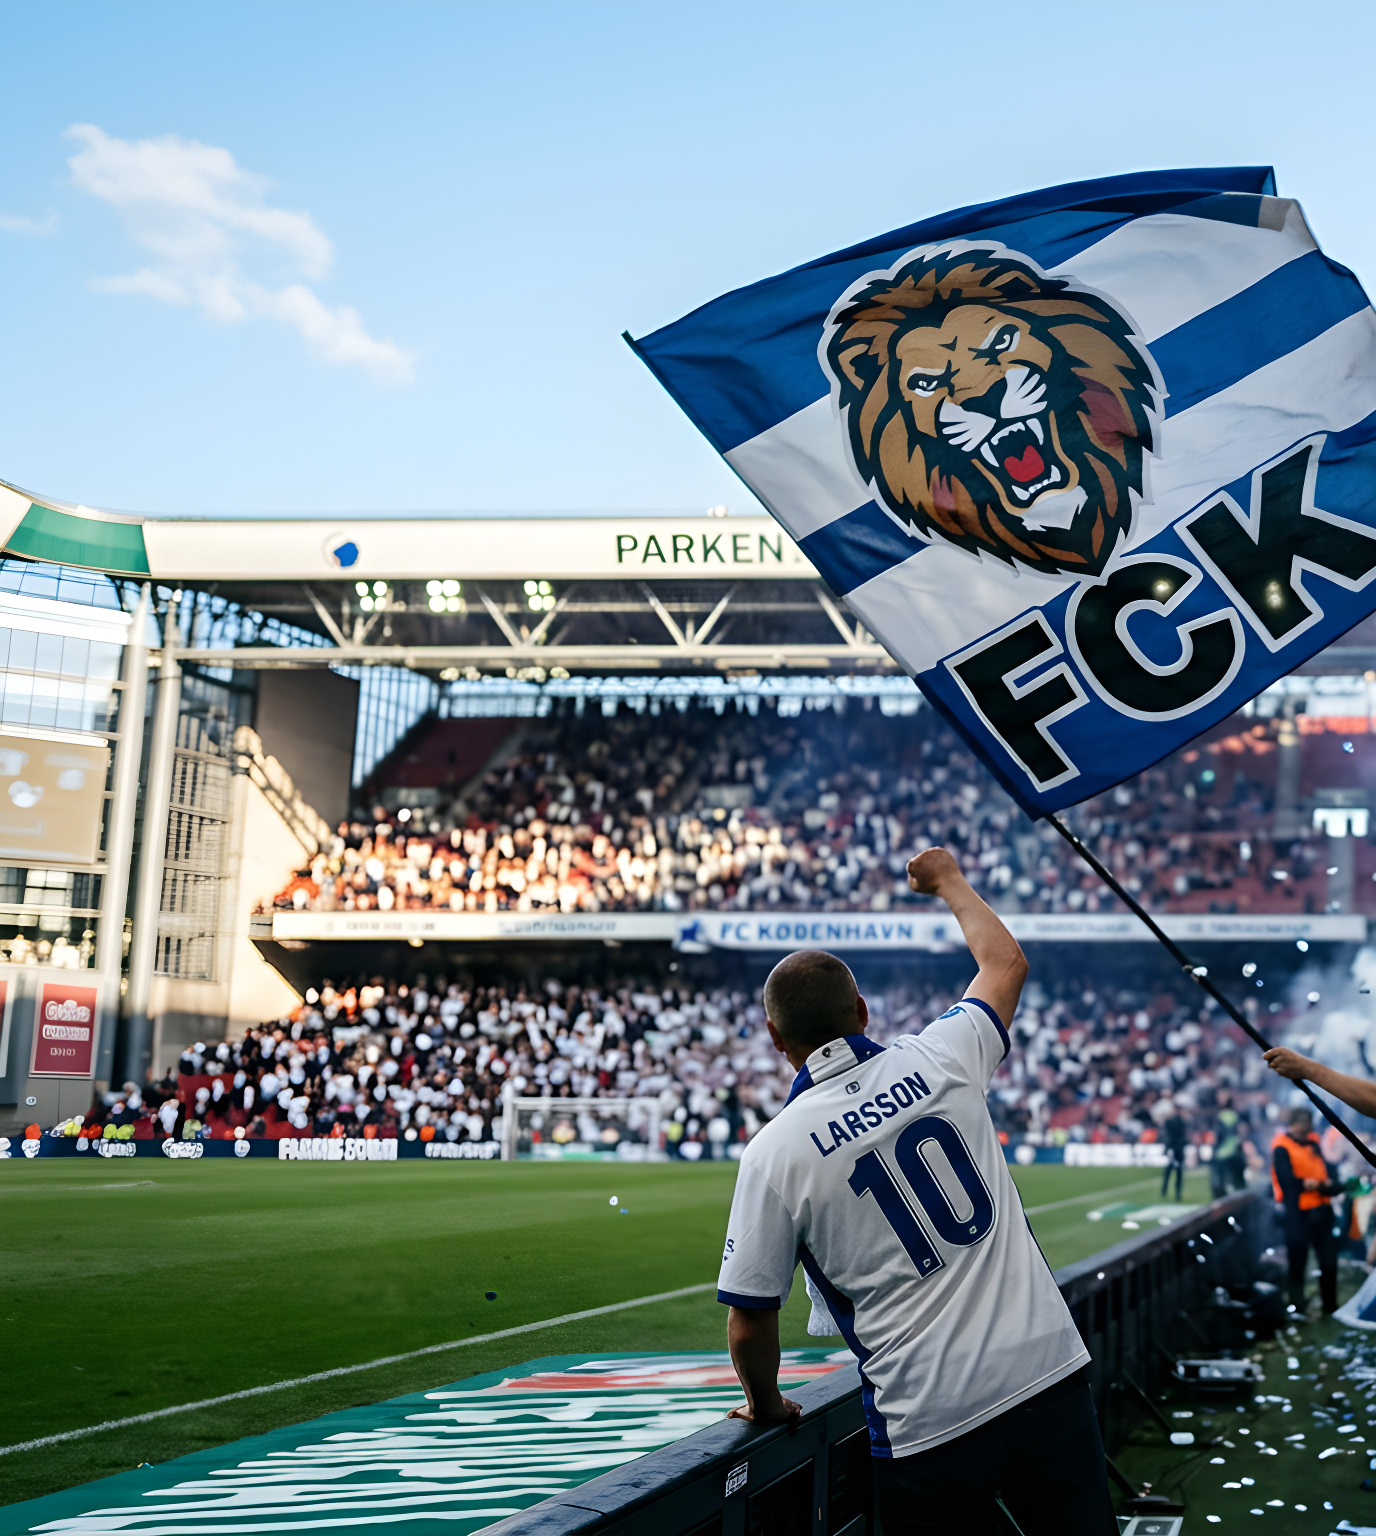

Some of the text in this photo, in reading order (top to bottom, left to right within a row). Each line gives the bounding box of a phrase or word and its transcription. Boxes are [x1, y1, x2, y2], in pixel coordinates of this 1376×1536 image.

[615, 533, 783, 564] PARKEN
[809, 1071, 932, 1158] LARSSON
[847, 1114, 997, 1280] 10
